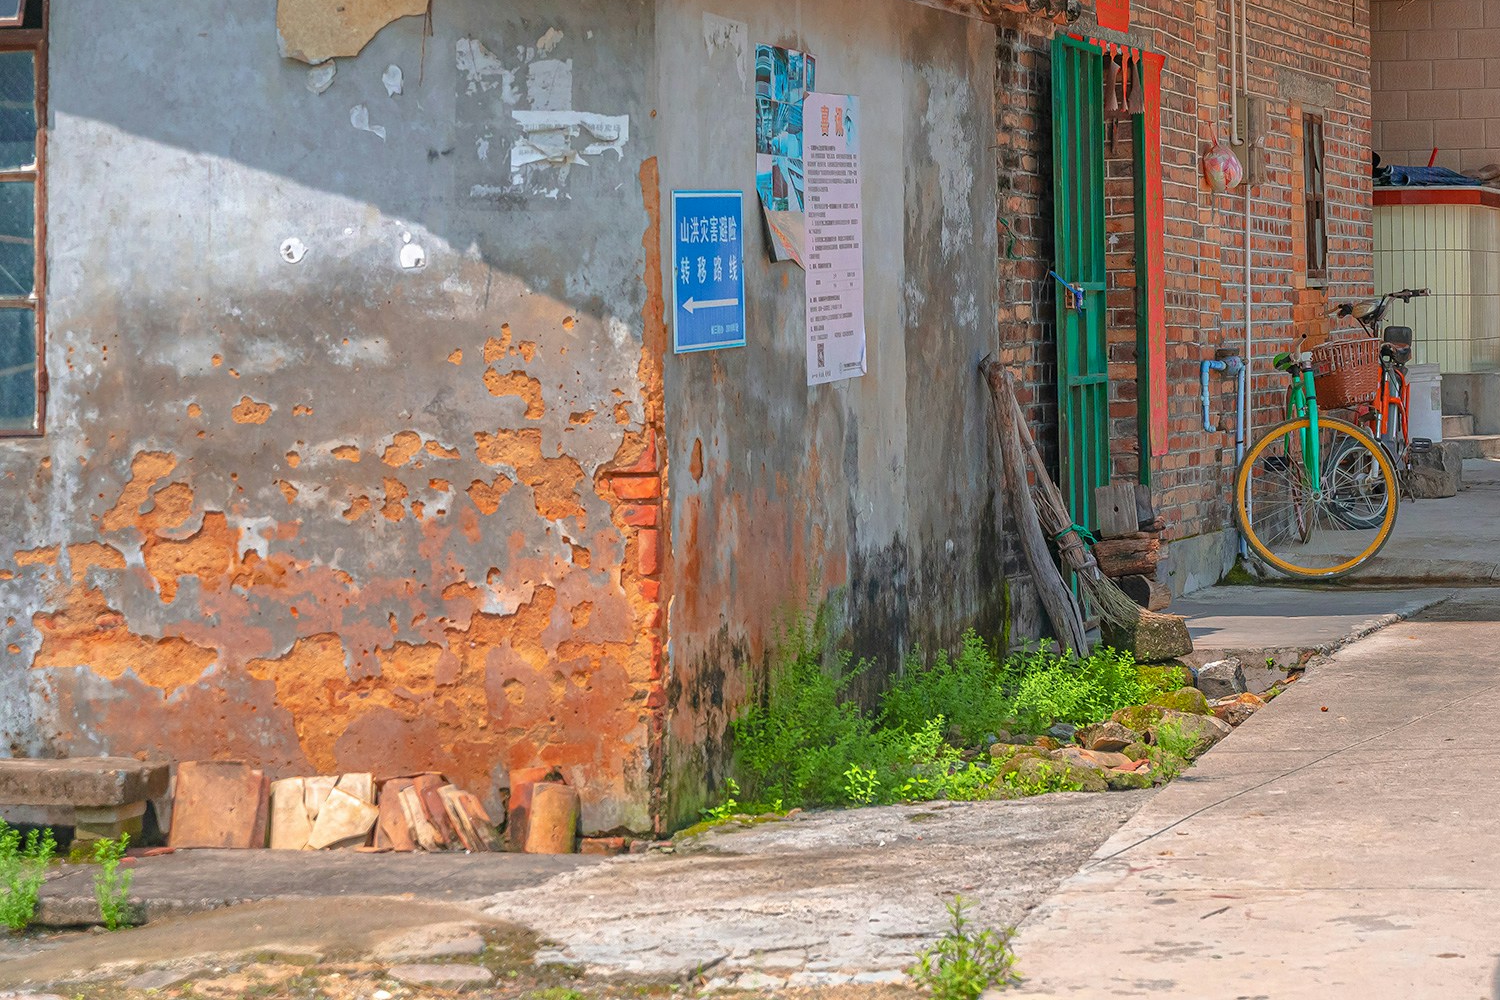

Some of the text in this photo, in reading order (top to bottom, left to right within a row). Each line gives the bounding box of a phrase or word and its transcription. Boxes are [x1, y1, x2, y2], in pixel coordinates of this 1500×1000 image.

[680, 216, 737, 244] 山洪灾害避险
[680, 255, 738, 285] 转移路线
